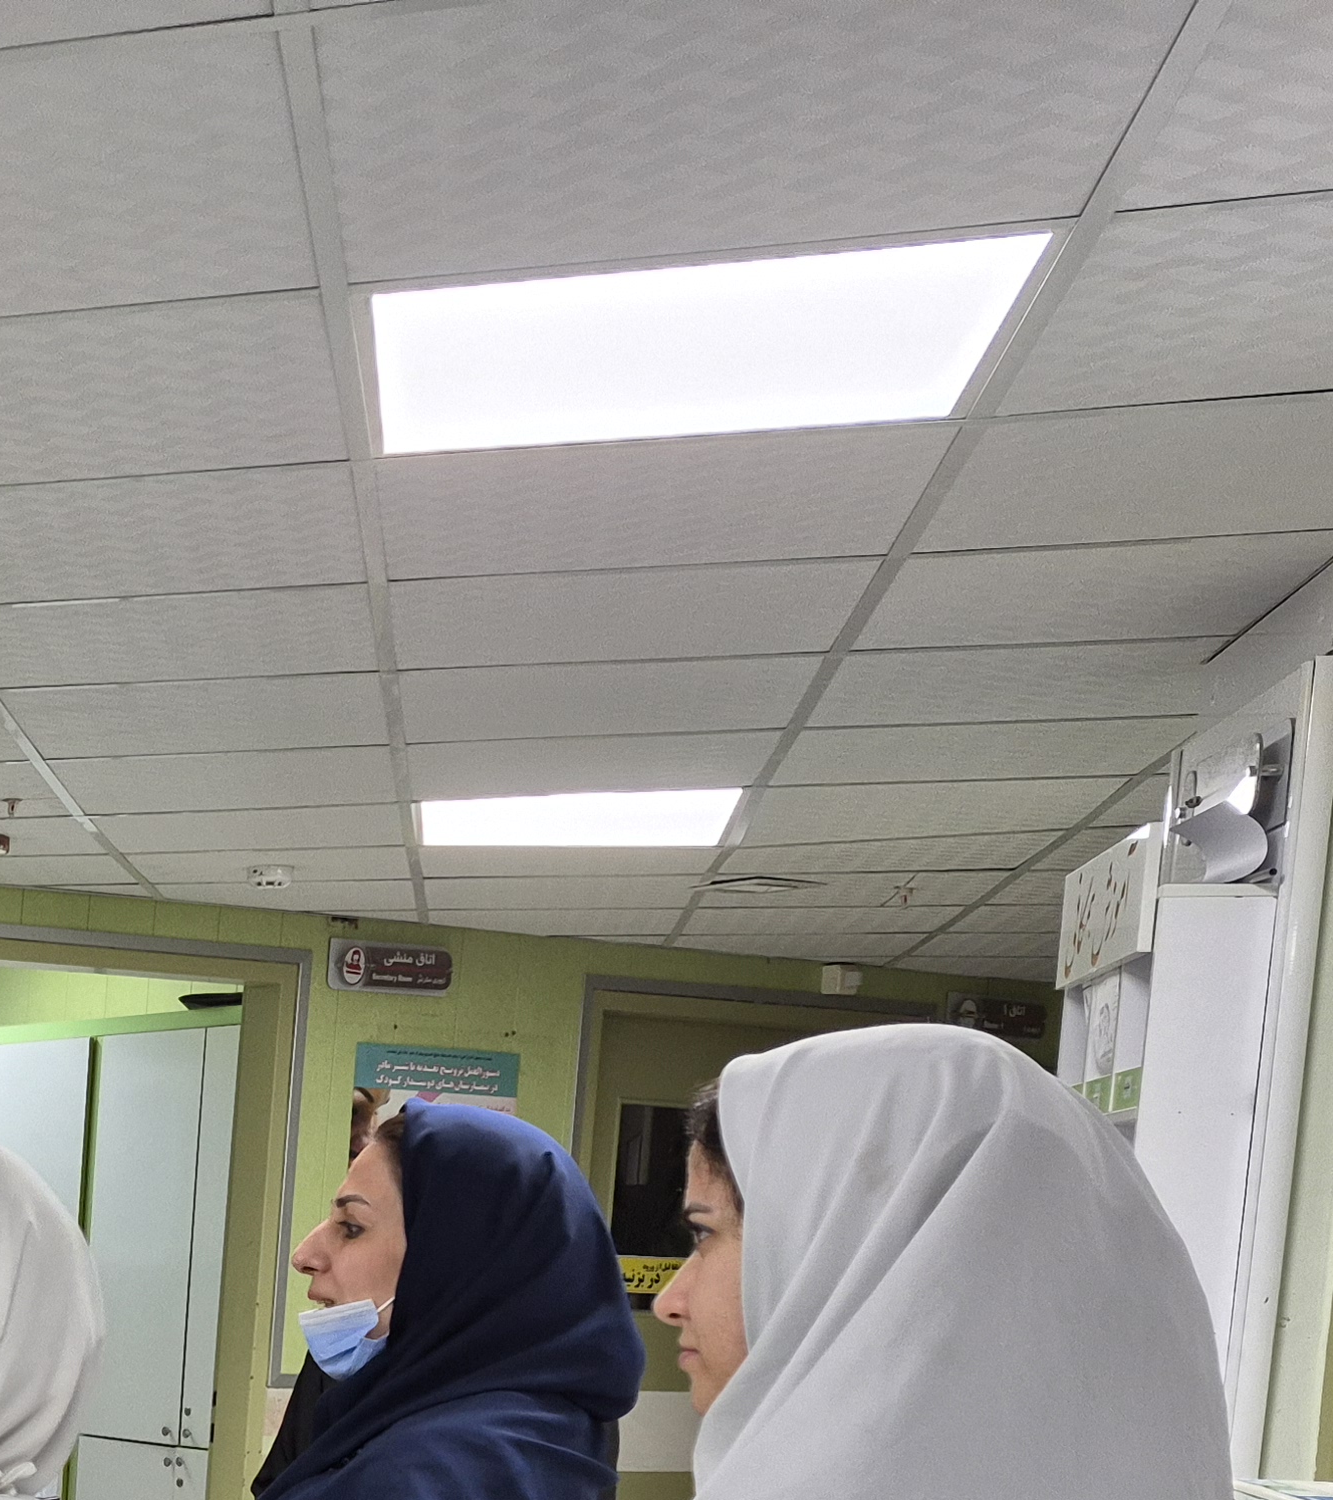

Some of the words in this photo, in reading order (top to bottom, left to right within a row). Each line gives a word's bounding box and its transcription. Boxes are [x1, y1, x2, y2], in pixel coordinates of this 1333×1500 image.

[383, 950, 414, 967] منشی
[415, 952, 437, 967] اتاق
[623, 1268, 645, 1288] بزنی
[647, 1272, 661, 1289] در
